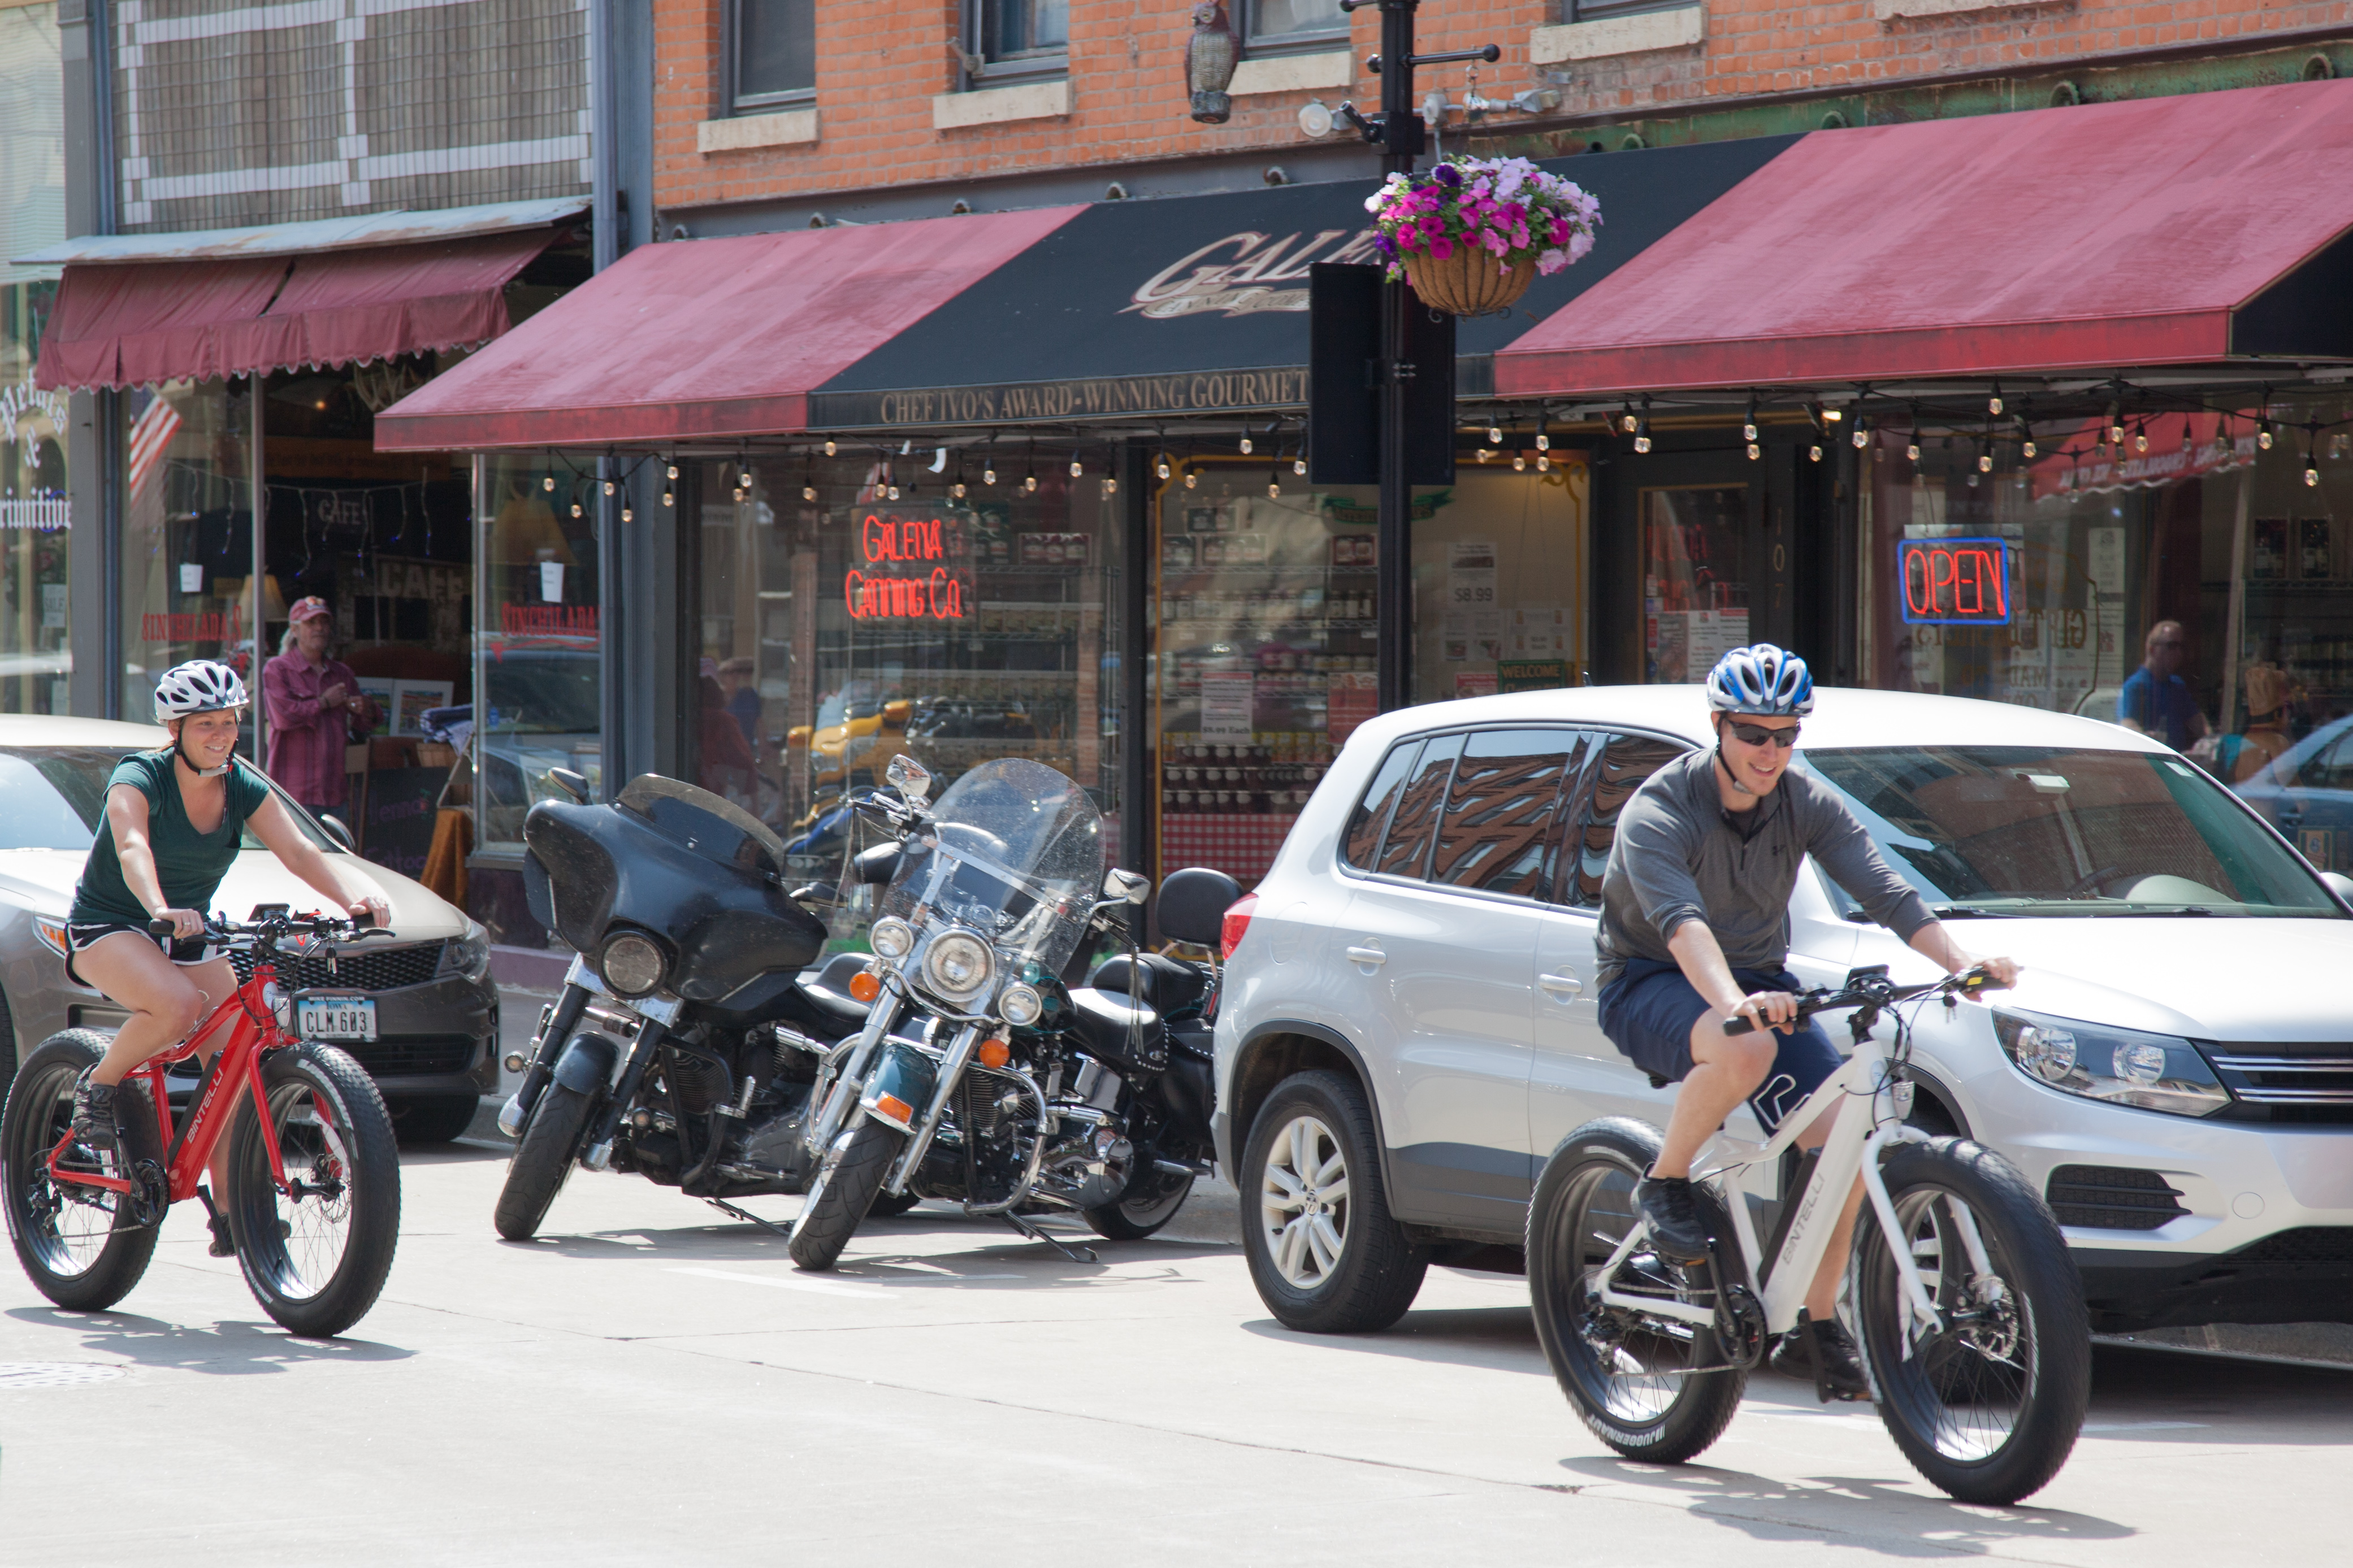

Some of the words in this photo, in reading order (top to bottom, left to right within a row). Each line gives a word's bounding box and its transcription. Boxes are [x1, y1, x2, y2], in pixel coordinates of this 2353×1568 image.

[880, 393, 934, 424] CHEF
[939, 389, 995, 421] IVO'S
[1189, 370, 1309, 409] GOURMET
[1454, 587, 1493, 603] $8.99
[1905, 549, 2006, 616] OPEN
[1501, 664, 1561, 678] WELCOME
[186, 1067, 224, 1144] BINTELLI
[1780, 1172, 1826, 1265] BINTELLI
[1586, 1413, 1656, 1447] JUGGERNAUT
